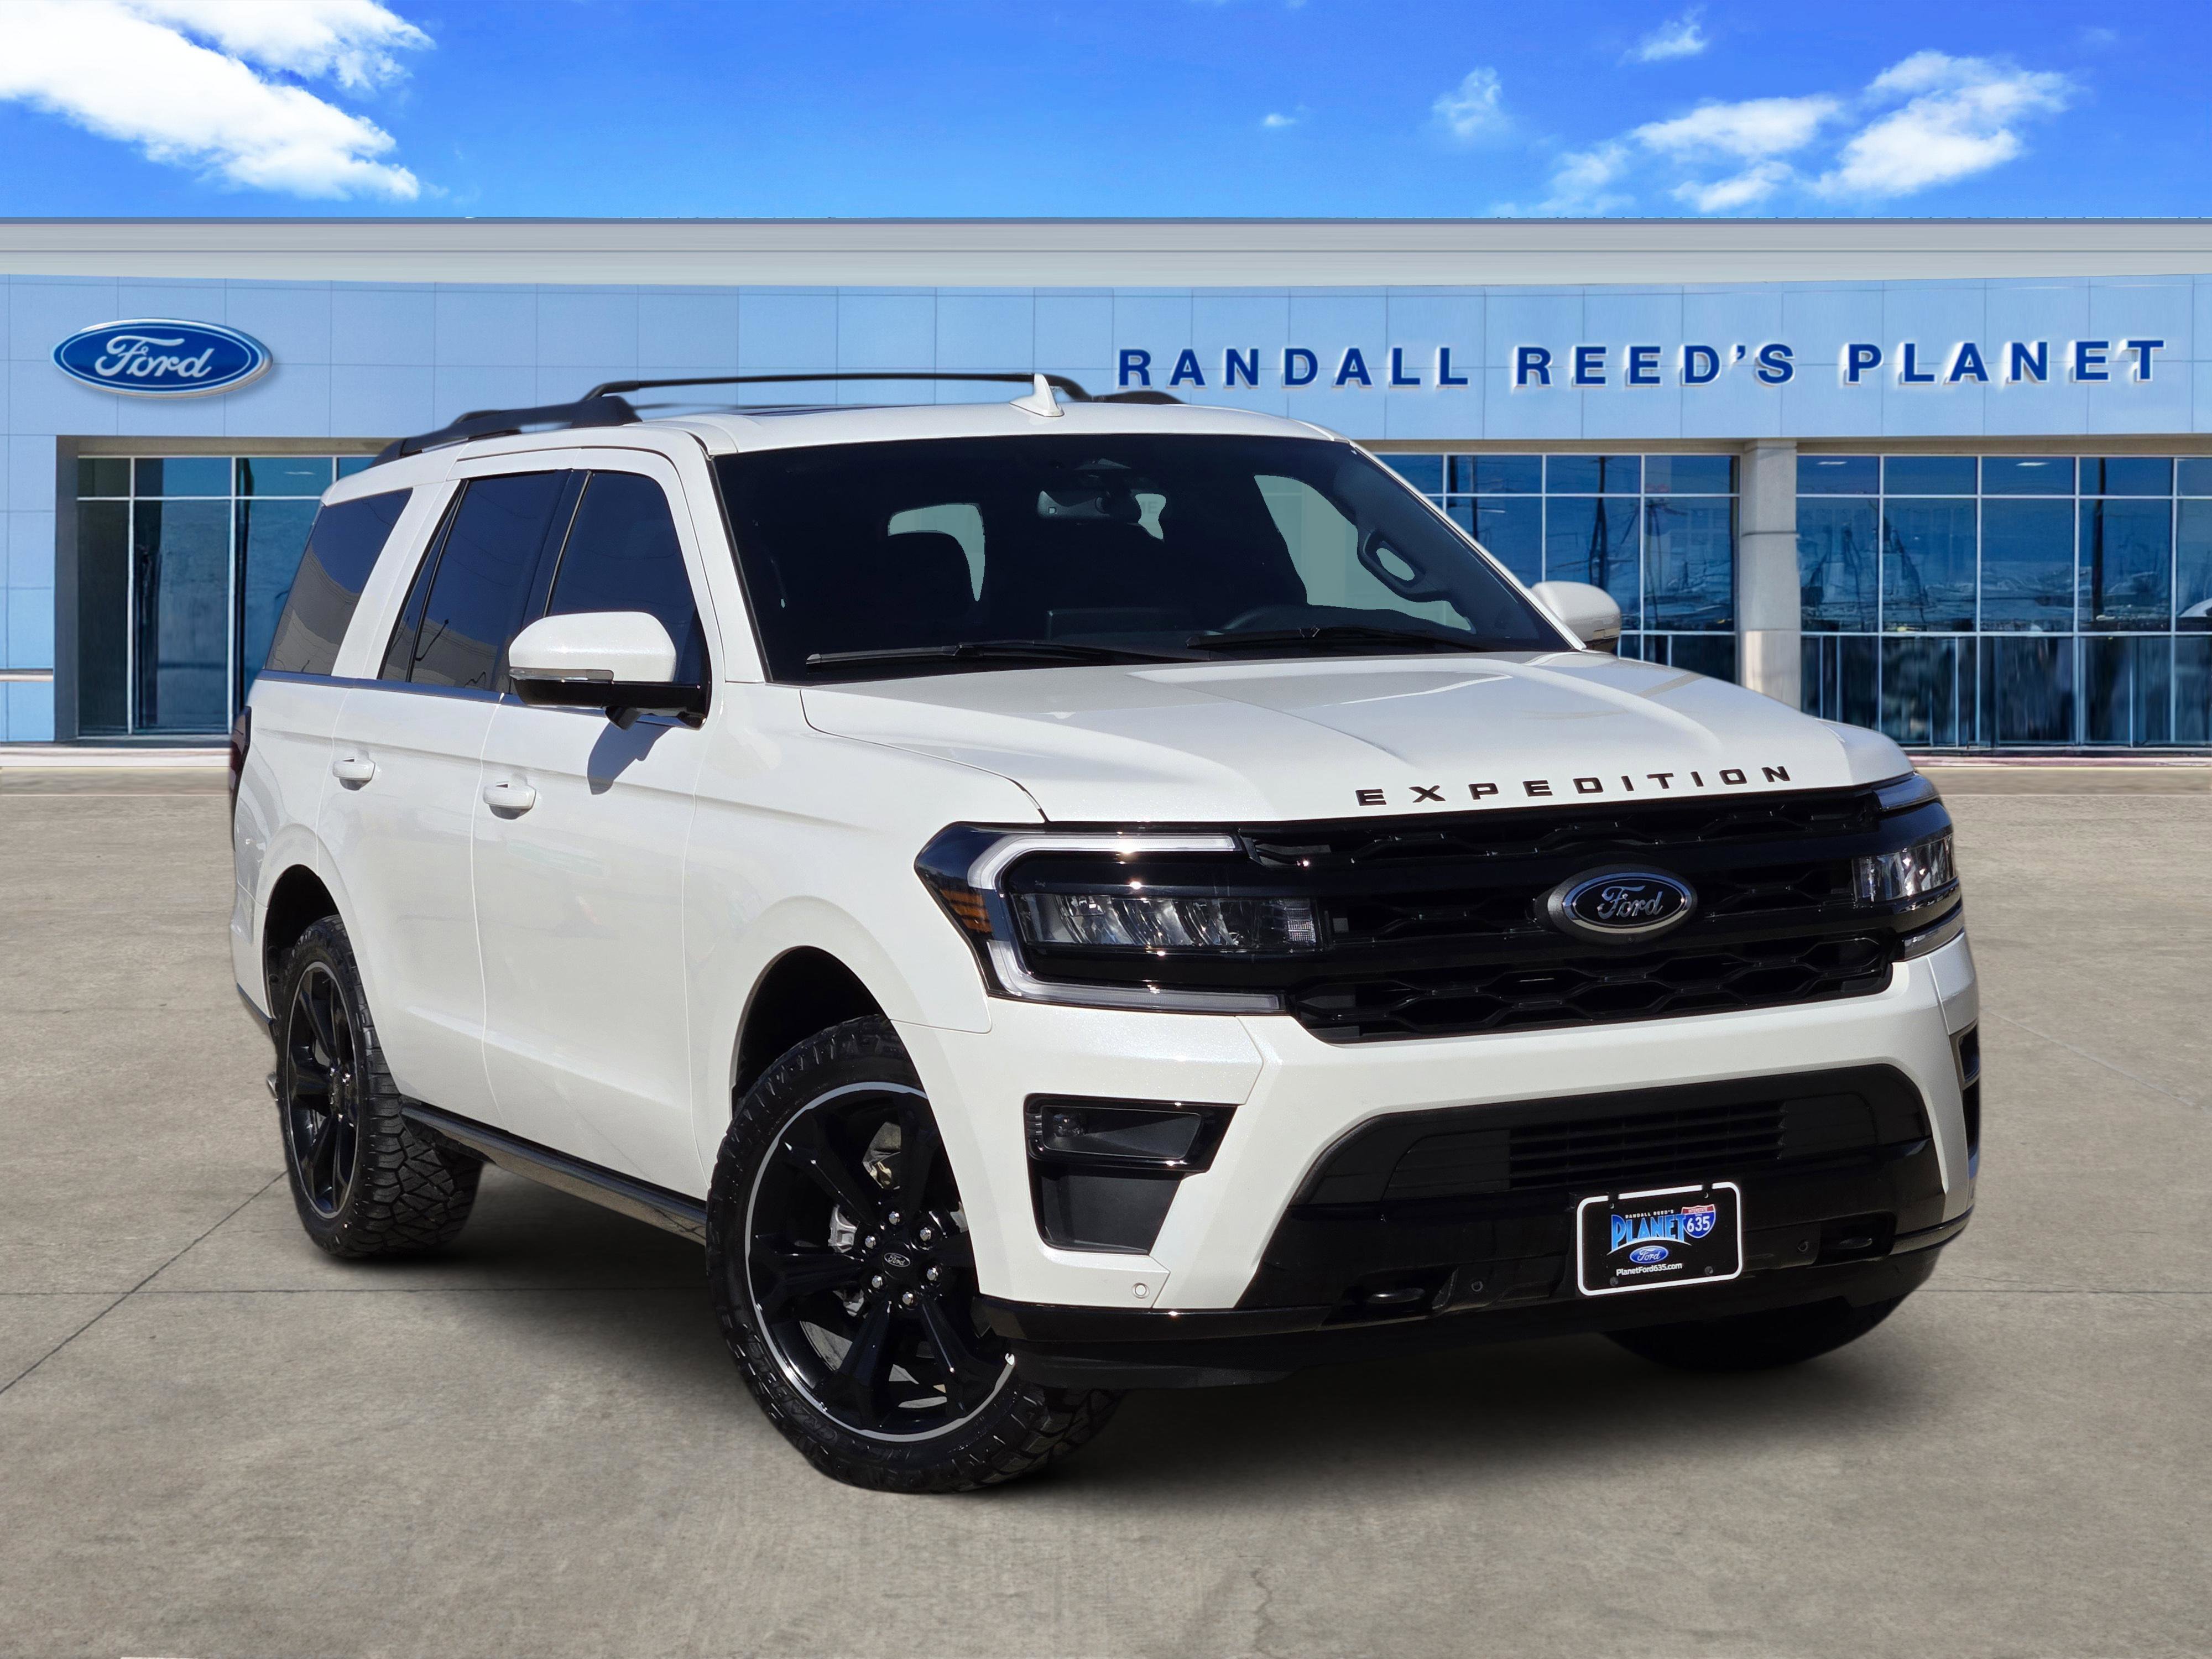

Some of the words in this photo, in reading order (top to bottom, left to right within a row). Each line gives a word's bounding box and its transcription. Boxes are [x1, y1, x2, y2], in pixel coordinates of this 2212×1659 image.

[95, 335, 215, 378] Ford
[1118, 347, 1470, 387] RANDALL
[1516, 343, 1794, 385] REED'S
[1847, 340, 2166, 383] PLANET
[1355, 765, 1792, 807] EXPEDITION
[1597, 885, 1663, 919] Ford
[1611, 1214, 1687, 1251] PLANET
[1687, 1216, 1710, 1233] 635
[1616, 1262, 1683, 1276] PlanetFord635.com
[1637, 1248, 1660, 1261] Ford
